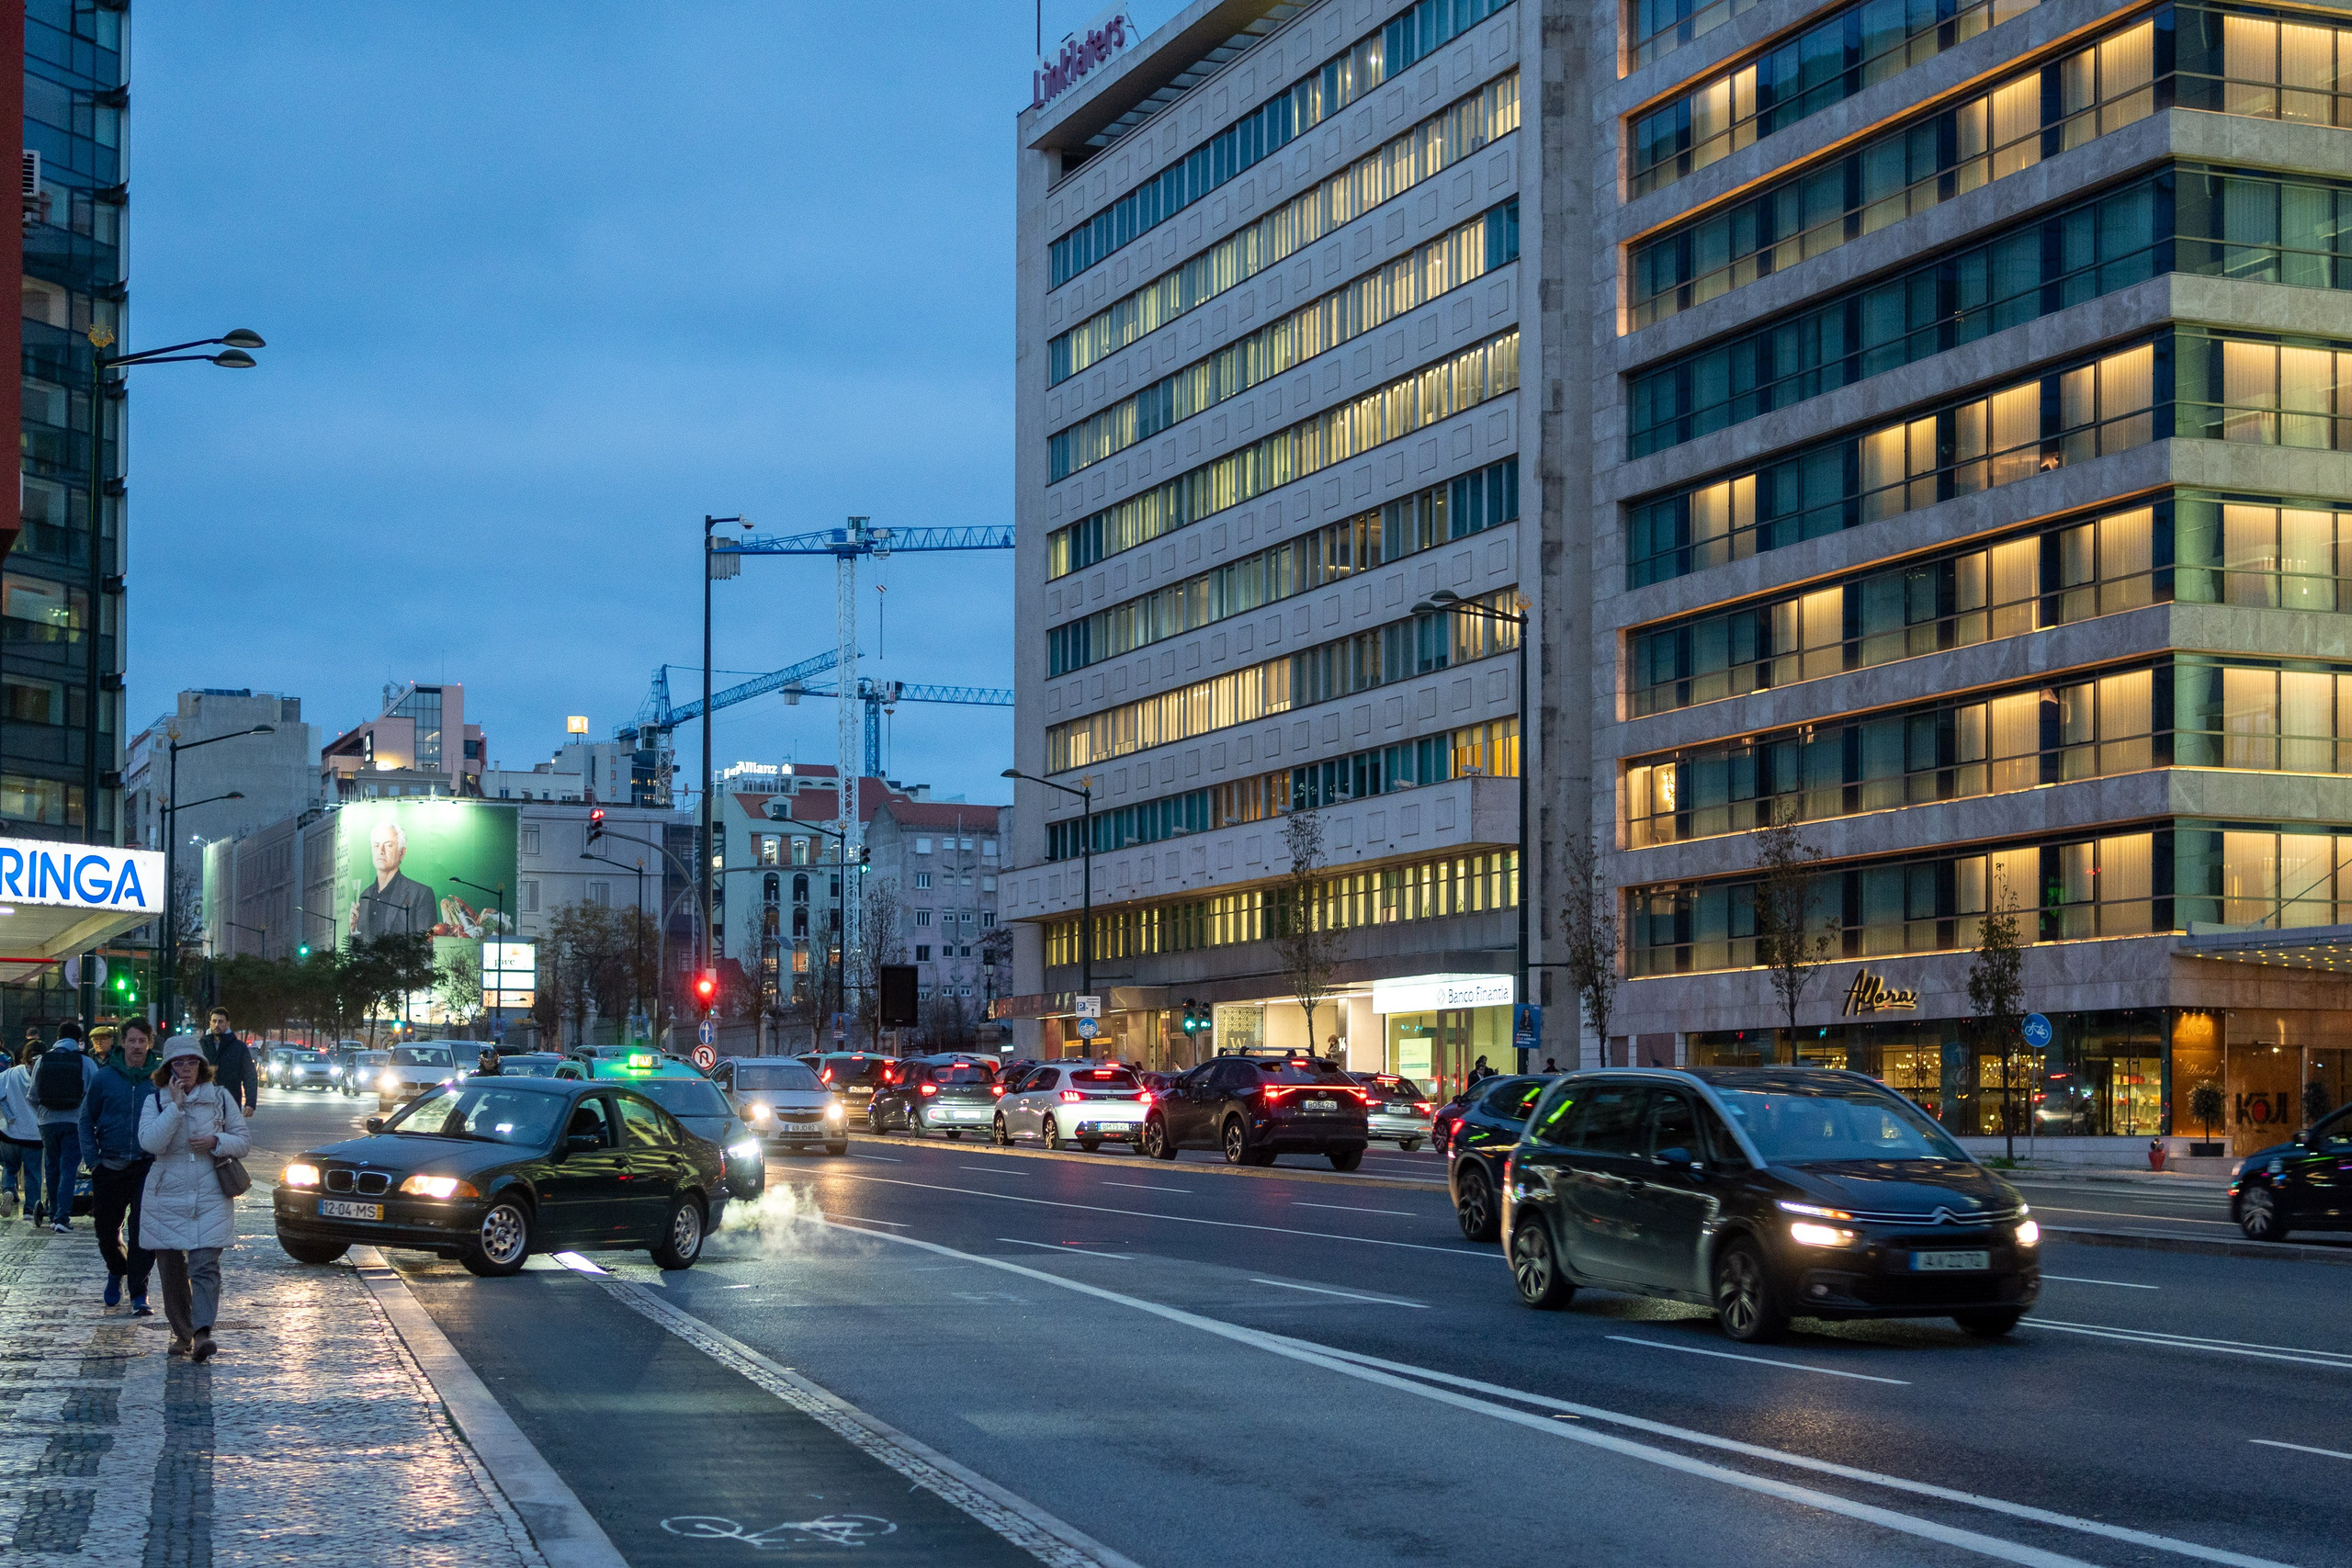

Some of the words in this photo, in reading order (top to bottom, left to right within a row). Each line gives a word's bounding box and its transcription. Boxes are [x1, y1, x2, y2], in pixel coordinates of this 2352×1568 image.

[1033, 15, 1125, 109] Linklaters
[736, 761, 778, 774] Allianz
[0, 847, 147, 908] RINGA
[1448, 988, 1475, 1004] Banco
[1476, 985, 1509, 1001] Finantia
[1338, 1037, 1347, 1052] 14
[638, 1055, 652, 1066] TAXI
